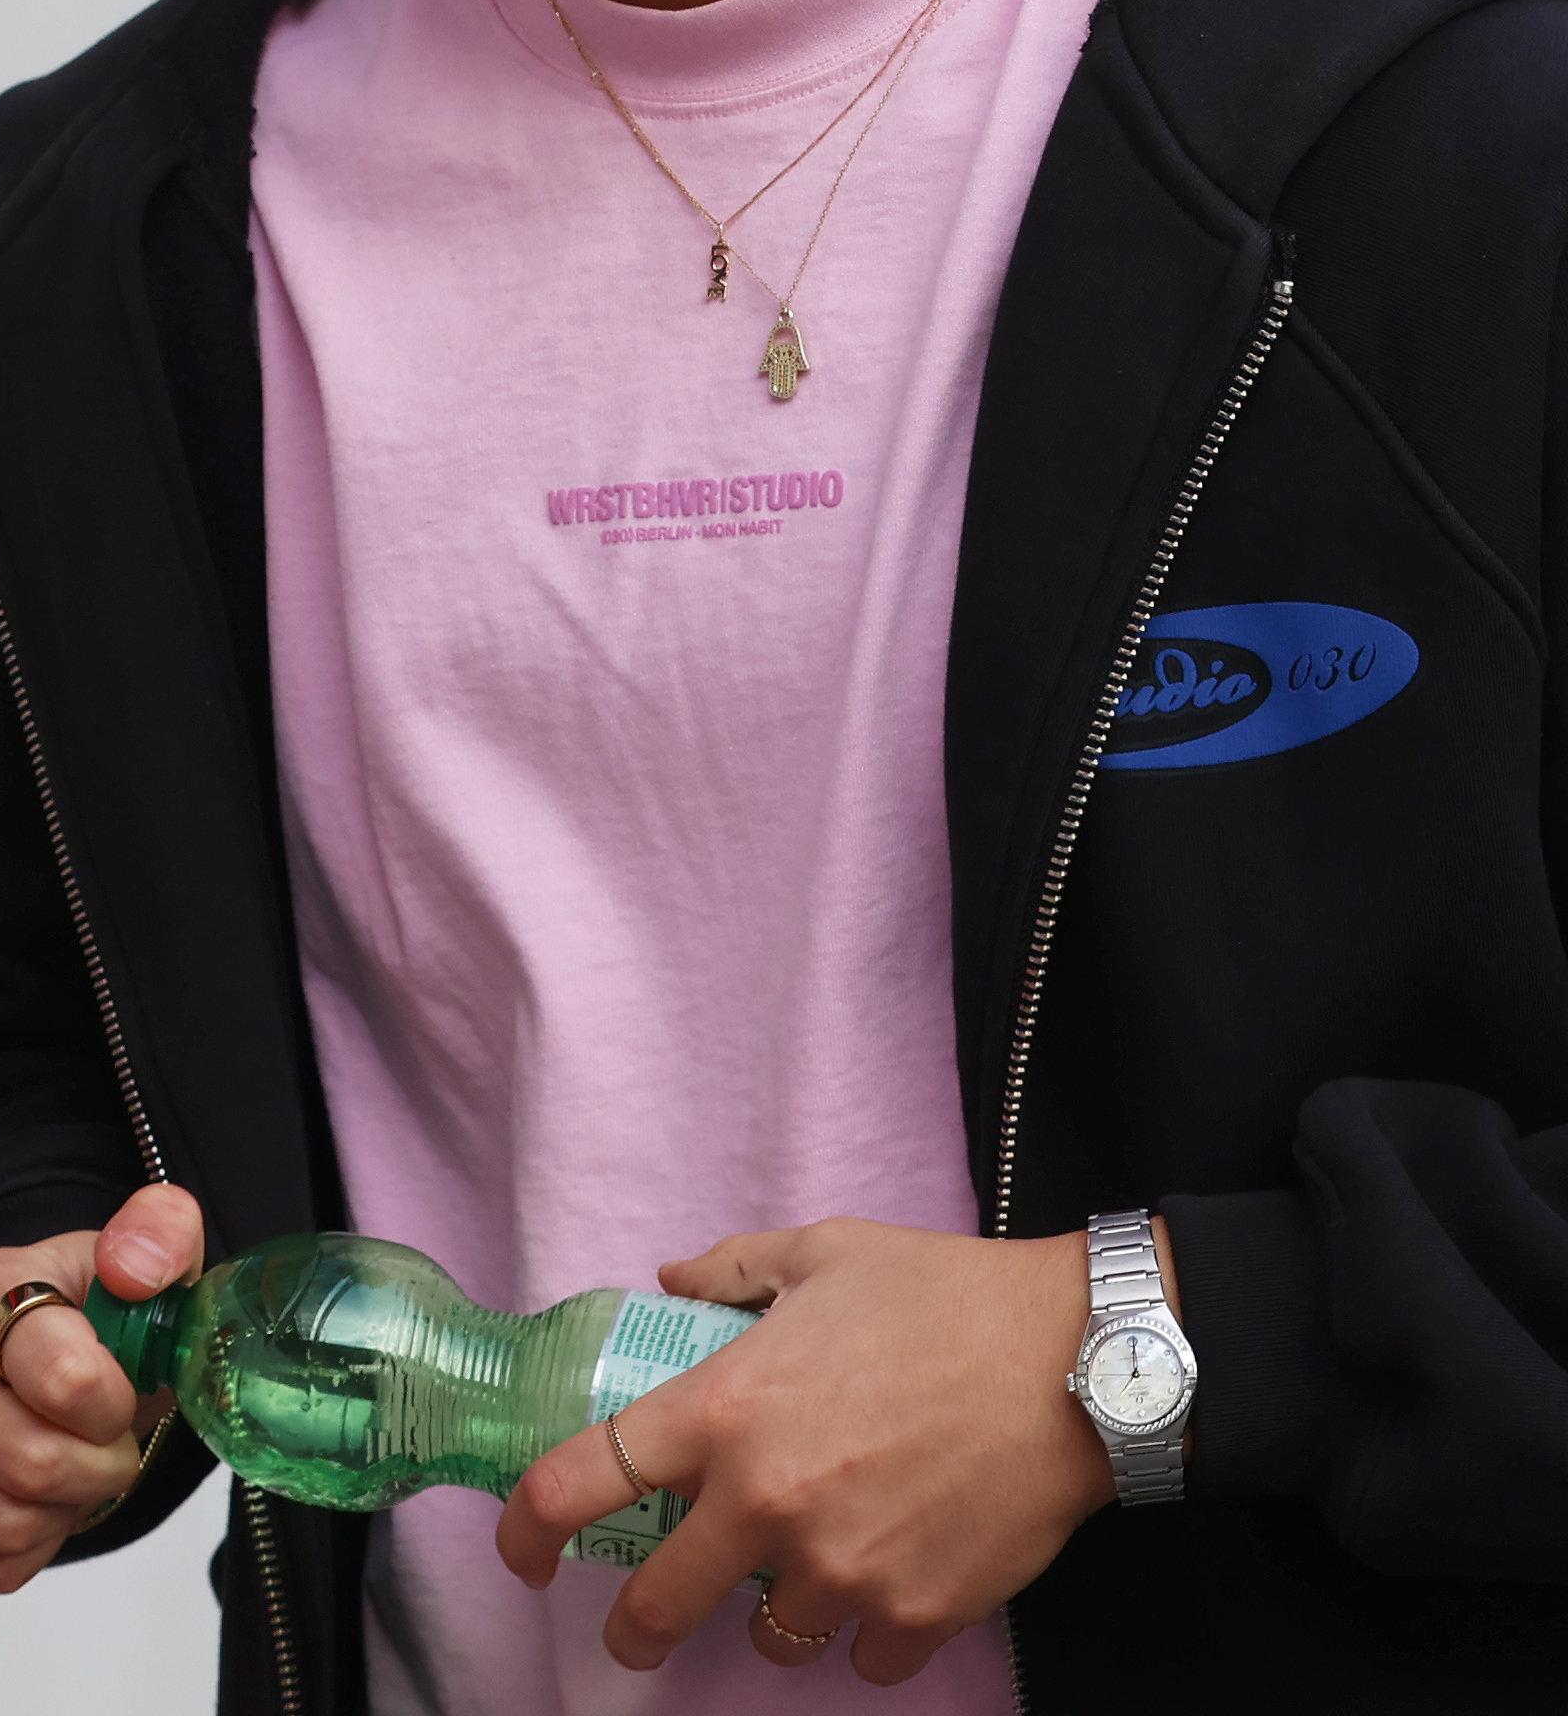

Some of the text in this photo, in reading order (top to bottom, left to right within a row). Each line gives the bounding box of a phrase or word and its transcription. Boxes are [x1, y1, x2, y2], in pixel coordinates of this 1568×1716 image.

[636, 525, 692, 542] BERLIN
[1114, 643, 1377, 720] udio 030
